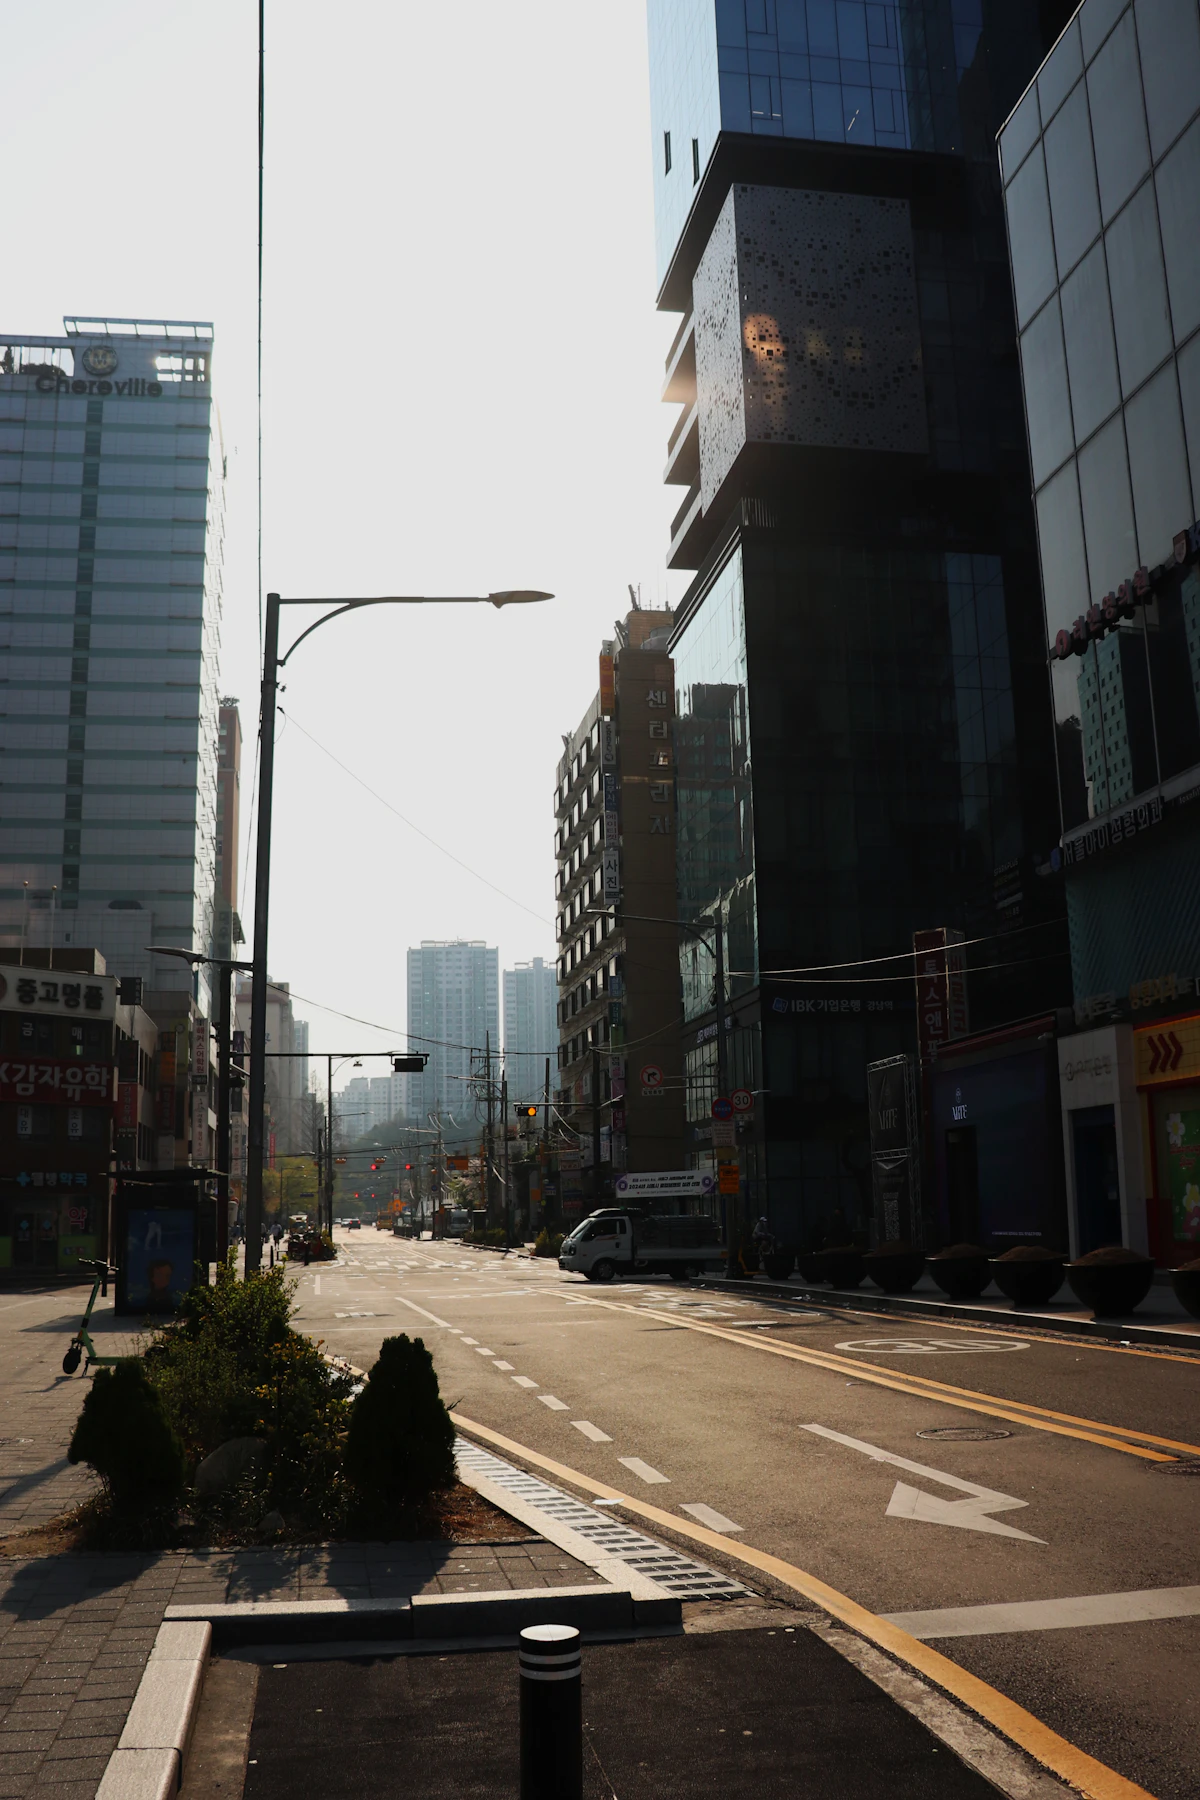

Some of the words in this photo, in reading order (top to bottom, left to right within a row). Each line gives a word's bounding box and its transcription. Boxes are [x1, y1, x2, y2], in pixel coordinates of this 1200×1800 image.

[36, 375, 163, 397] Chereville
[605, 859, 618, 889] 사진
[17, 978, 104, 1010] 중고명품
[791, 999, 816, 1012] IBK
[817, 999, 861, 1012] 기업은행
[734, 1095, 749, 1106] 30
[68, 1205, 88, 1230] 약
